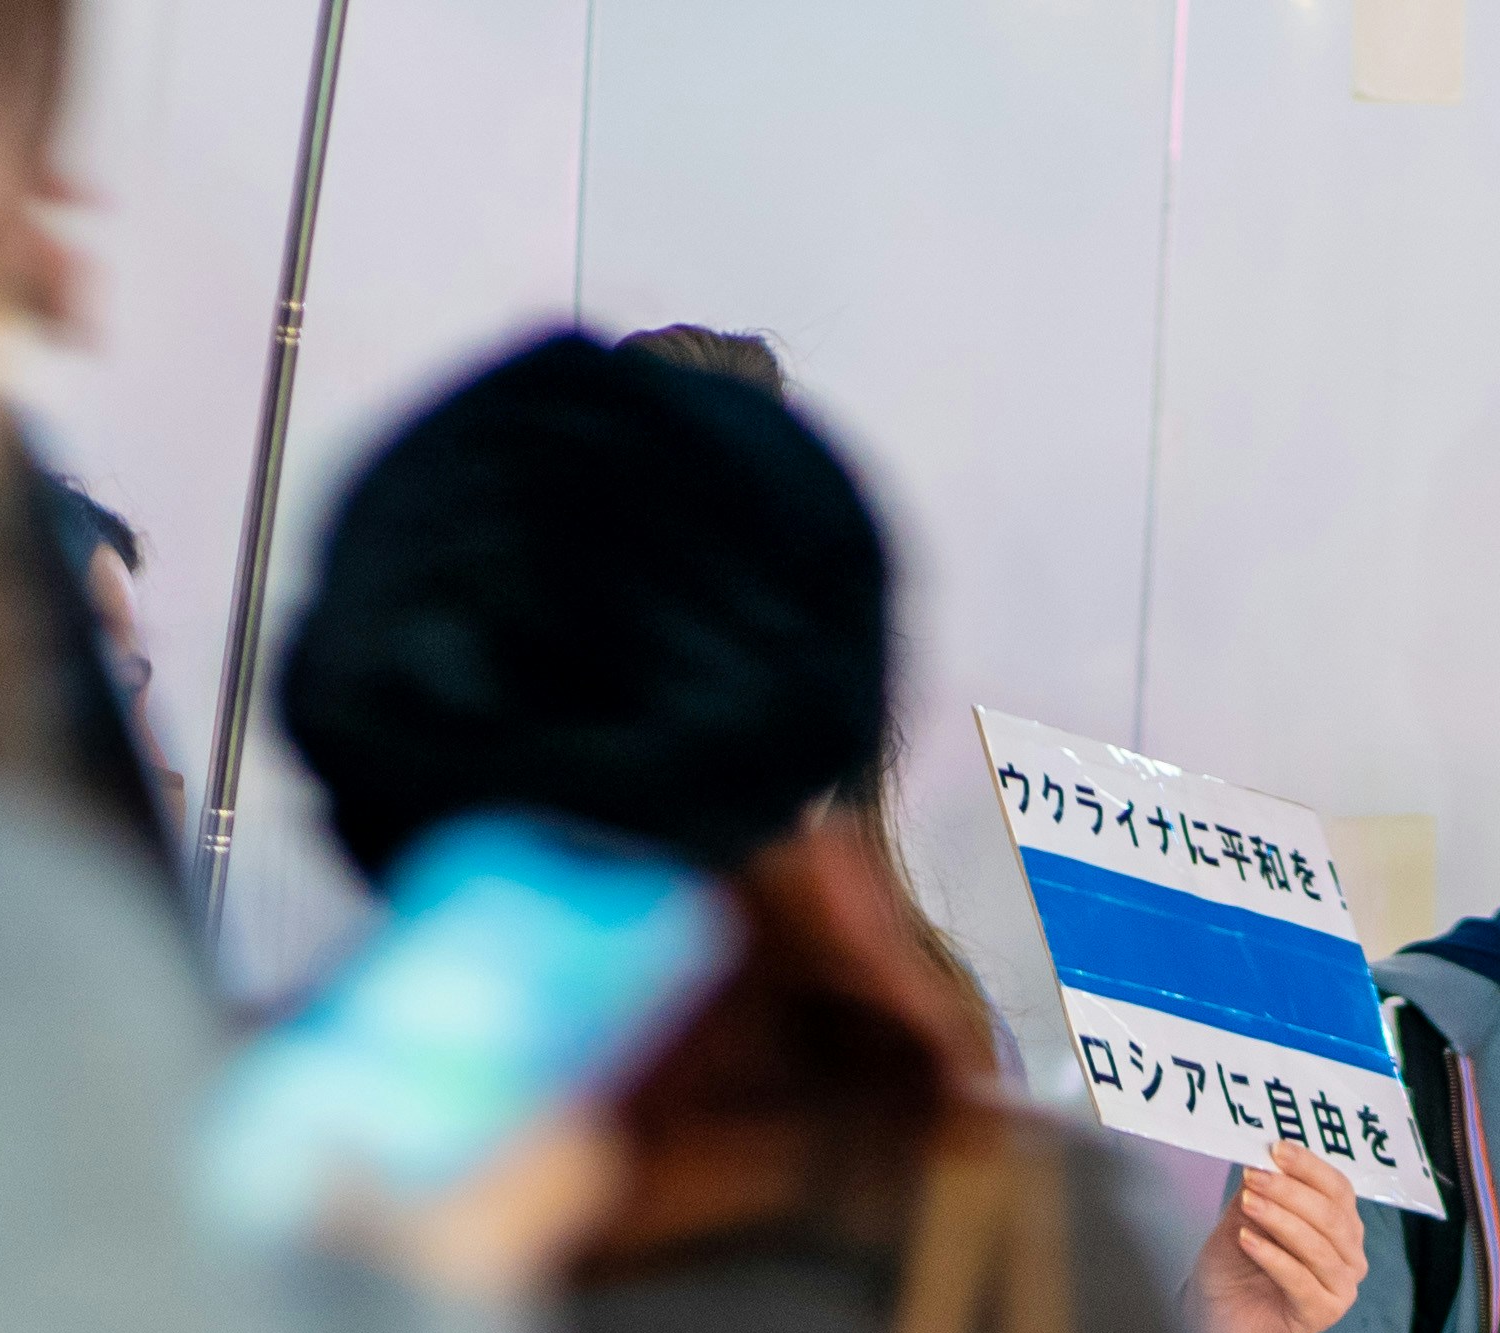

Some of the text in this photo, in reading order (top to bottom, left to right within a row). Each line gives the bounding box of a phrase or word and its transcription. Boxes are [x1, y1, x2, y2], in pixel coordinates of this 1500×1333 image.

[997, 764, 1348, 910] ウクライナに平和を！
[1079, 1034, 1430, 1177] ロシアに自由を！
